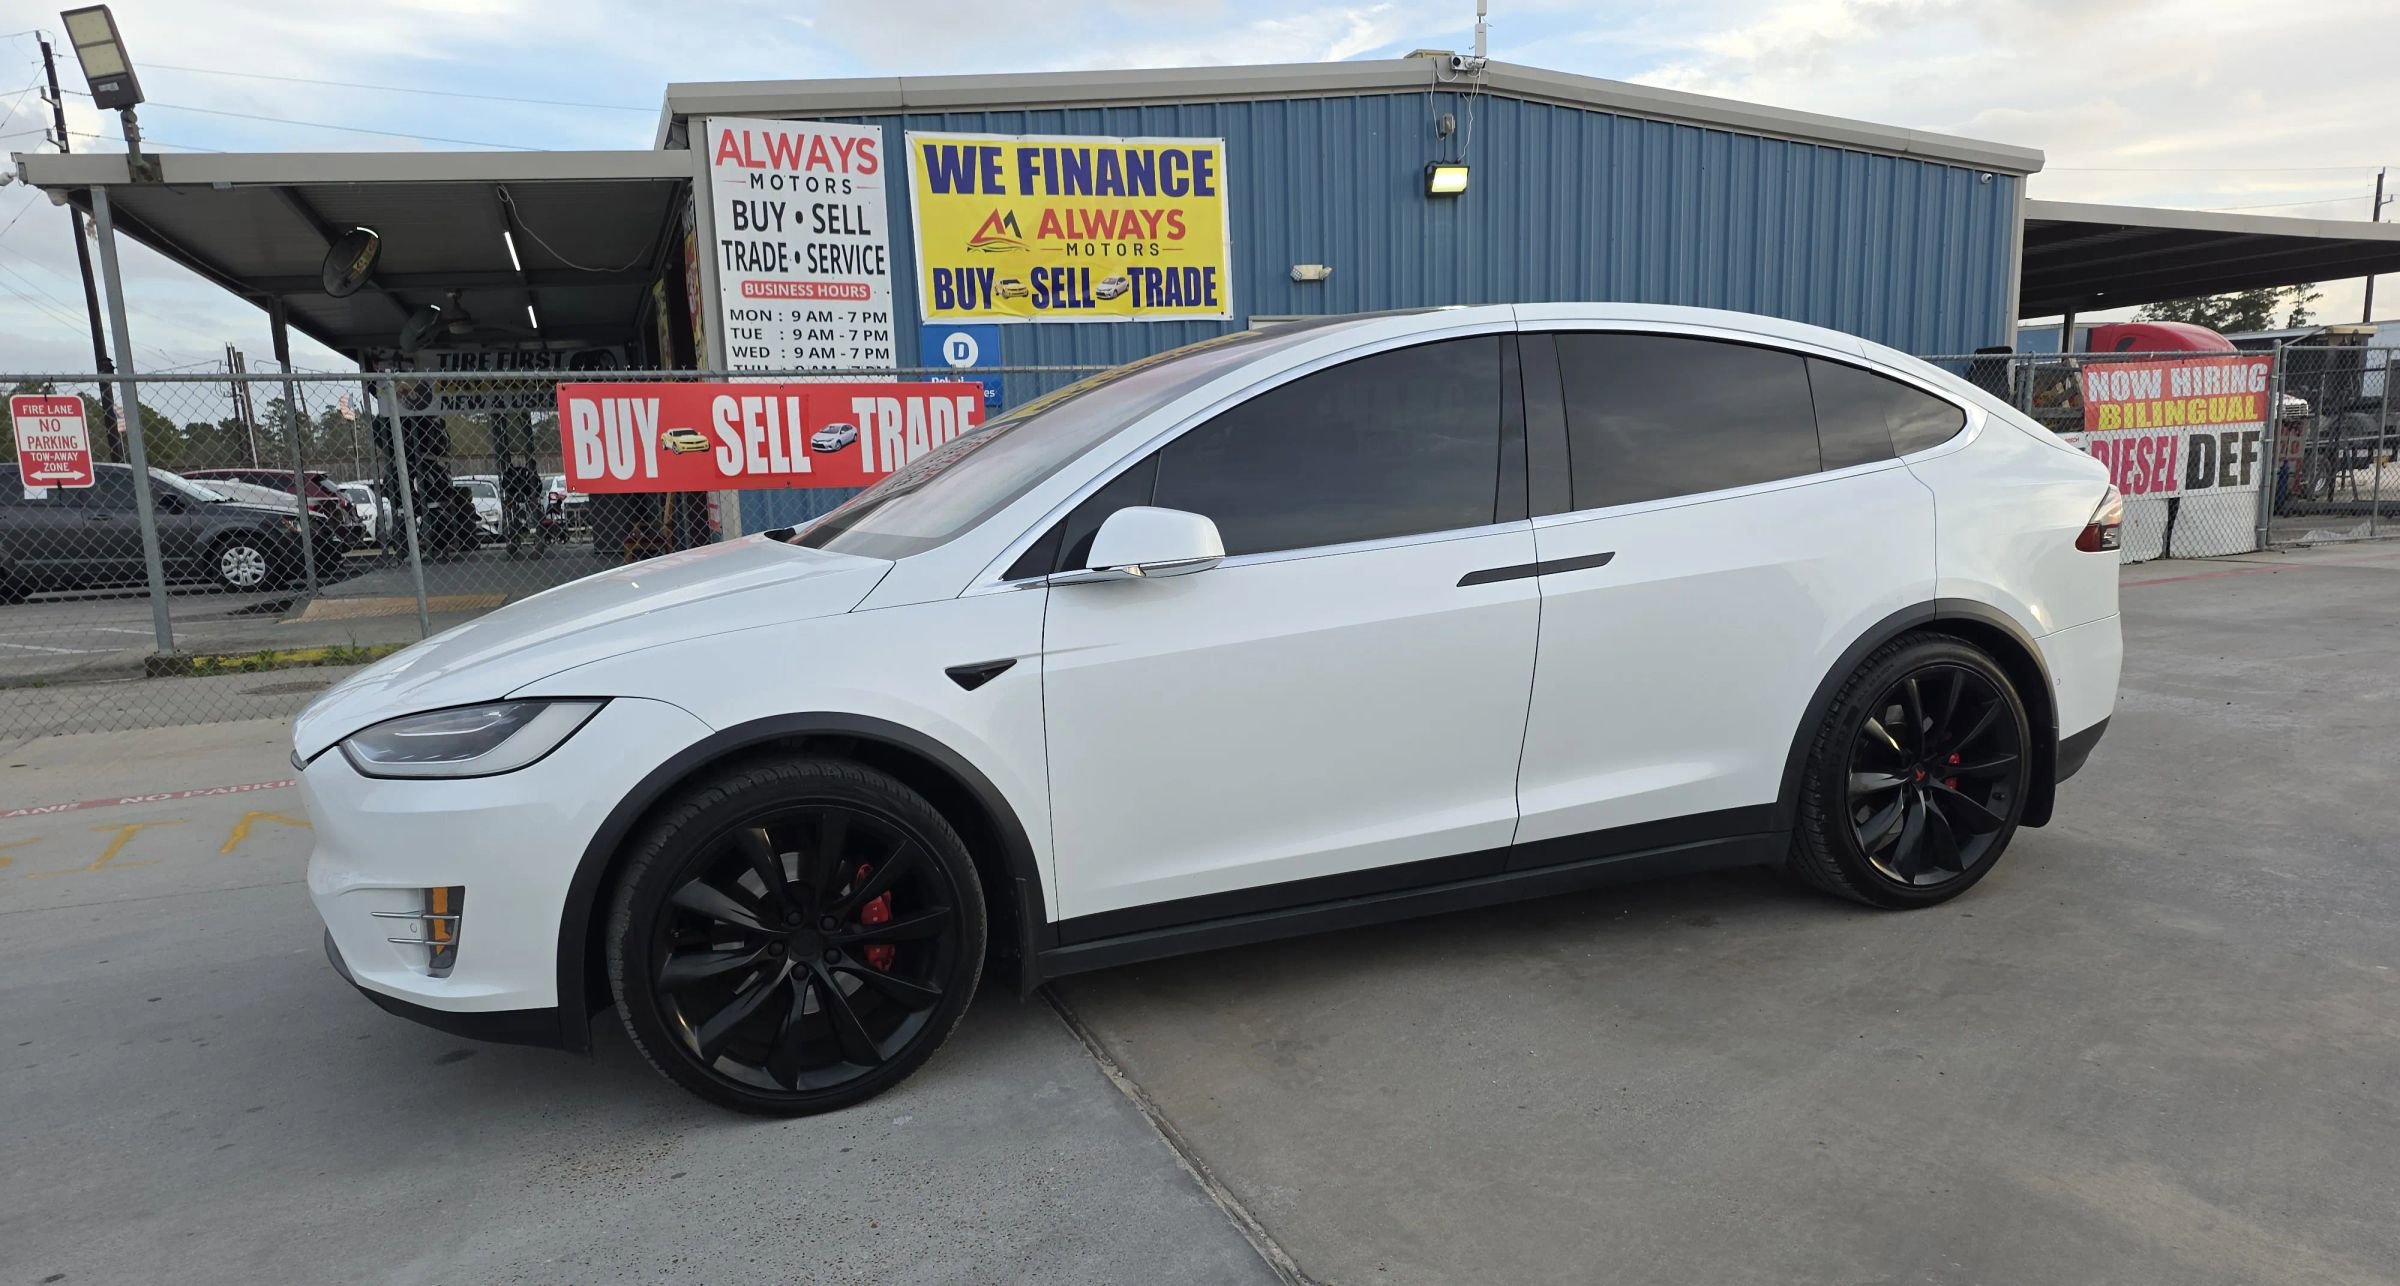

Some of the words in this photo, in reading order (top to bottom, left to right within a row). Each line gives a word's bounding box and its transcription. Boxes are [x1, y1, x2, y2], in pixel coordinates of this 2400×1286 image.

[715, 129, 878, 175] ALWAYS
[923, 144, 1006, 194] WE
[1017, 147, 1215, 197] FINANCE
[751, 173, 852, 194] MOTORS
[732, 200, 785, 232] BUY
[812, 204, 871, 235] SELL
[1037, 208, 1186, 240] ALWAYS
[722, 240, 788, 272] TRADE
[807, 243, 885, 275] SERVICE
[1067, 243, 1159, 256] MOTORS
[745, 283, 813, 297] BUSINESS
[818, 284, 867, 298] HOURS
[933, 267, 994, 310] BUY
[1030, 267, 1096, 309] SELL
[1127, 266, 1217, 307] TRADE
[730, 309, 772, 321] MON
[792, 310, 800, 322] 9
[806, 311, 832, 323] AM
[848, 312, 856, 323] 7
[863, 312, 887, 323] PM
[731, 327, 762, 340] TUE
[793, 329, 802, 340] 9
[807, 329, 834, 341] AM
[849, 330, 858, 341] 7
[864, 330, 888, 341] PM
[436, 352, 490, 370] TIRE
[496, 351, 565, 370] FIRST
[732, 346, 770, 358] WED
[794, 347, 803, 358] 9
[809, 348, 835, 359] AM
[851, 348, 859, 359] 7
[865, 348, 889, 359] PM
[2088, 369, 2162, 402] NOW
[2171, 363, 2268, 397] HIRING
[23, 405, 44, 414] FIRE
[48, 405, 73, 414] LANE
[2098, 396, 2257, 430] BILINGUAL
[39, 419, 60, 432] NO
[27, 436, 77, 449] PARKING
[570, 398, 660, 480] BUY
[712, 395, 811, 475] SELL
[31, 452, 78, 461] TOW-AWAY
[2185, 430, 2260, 490] DEF
[44, 463, 70, 471] ZONE
